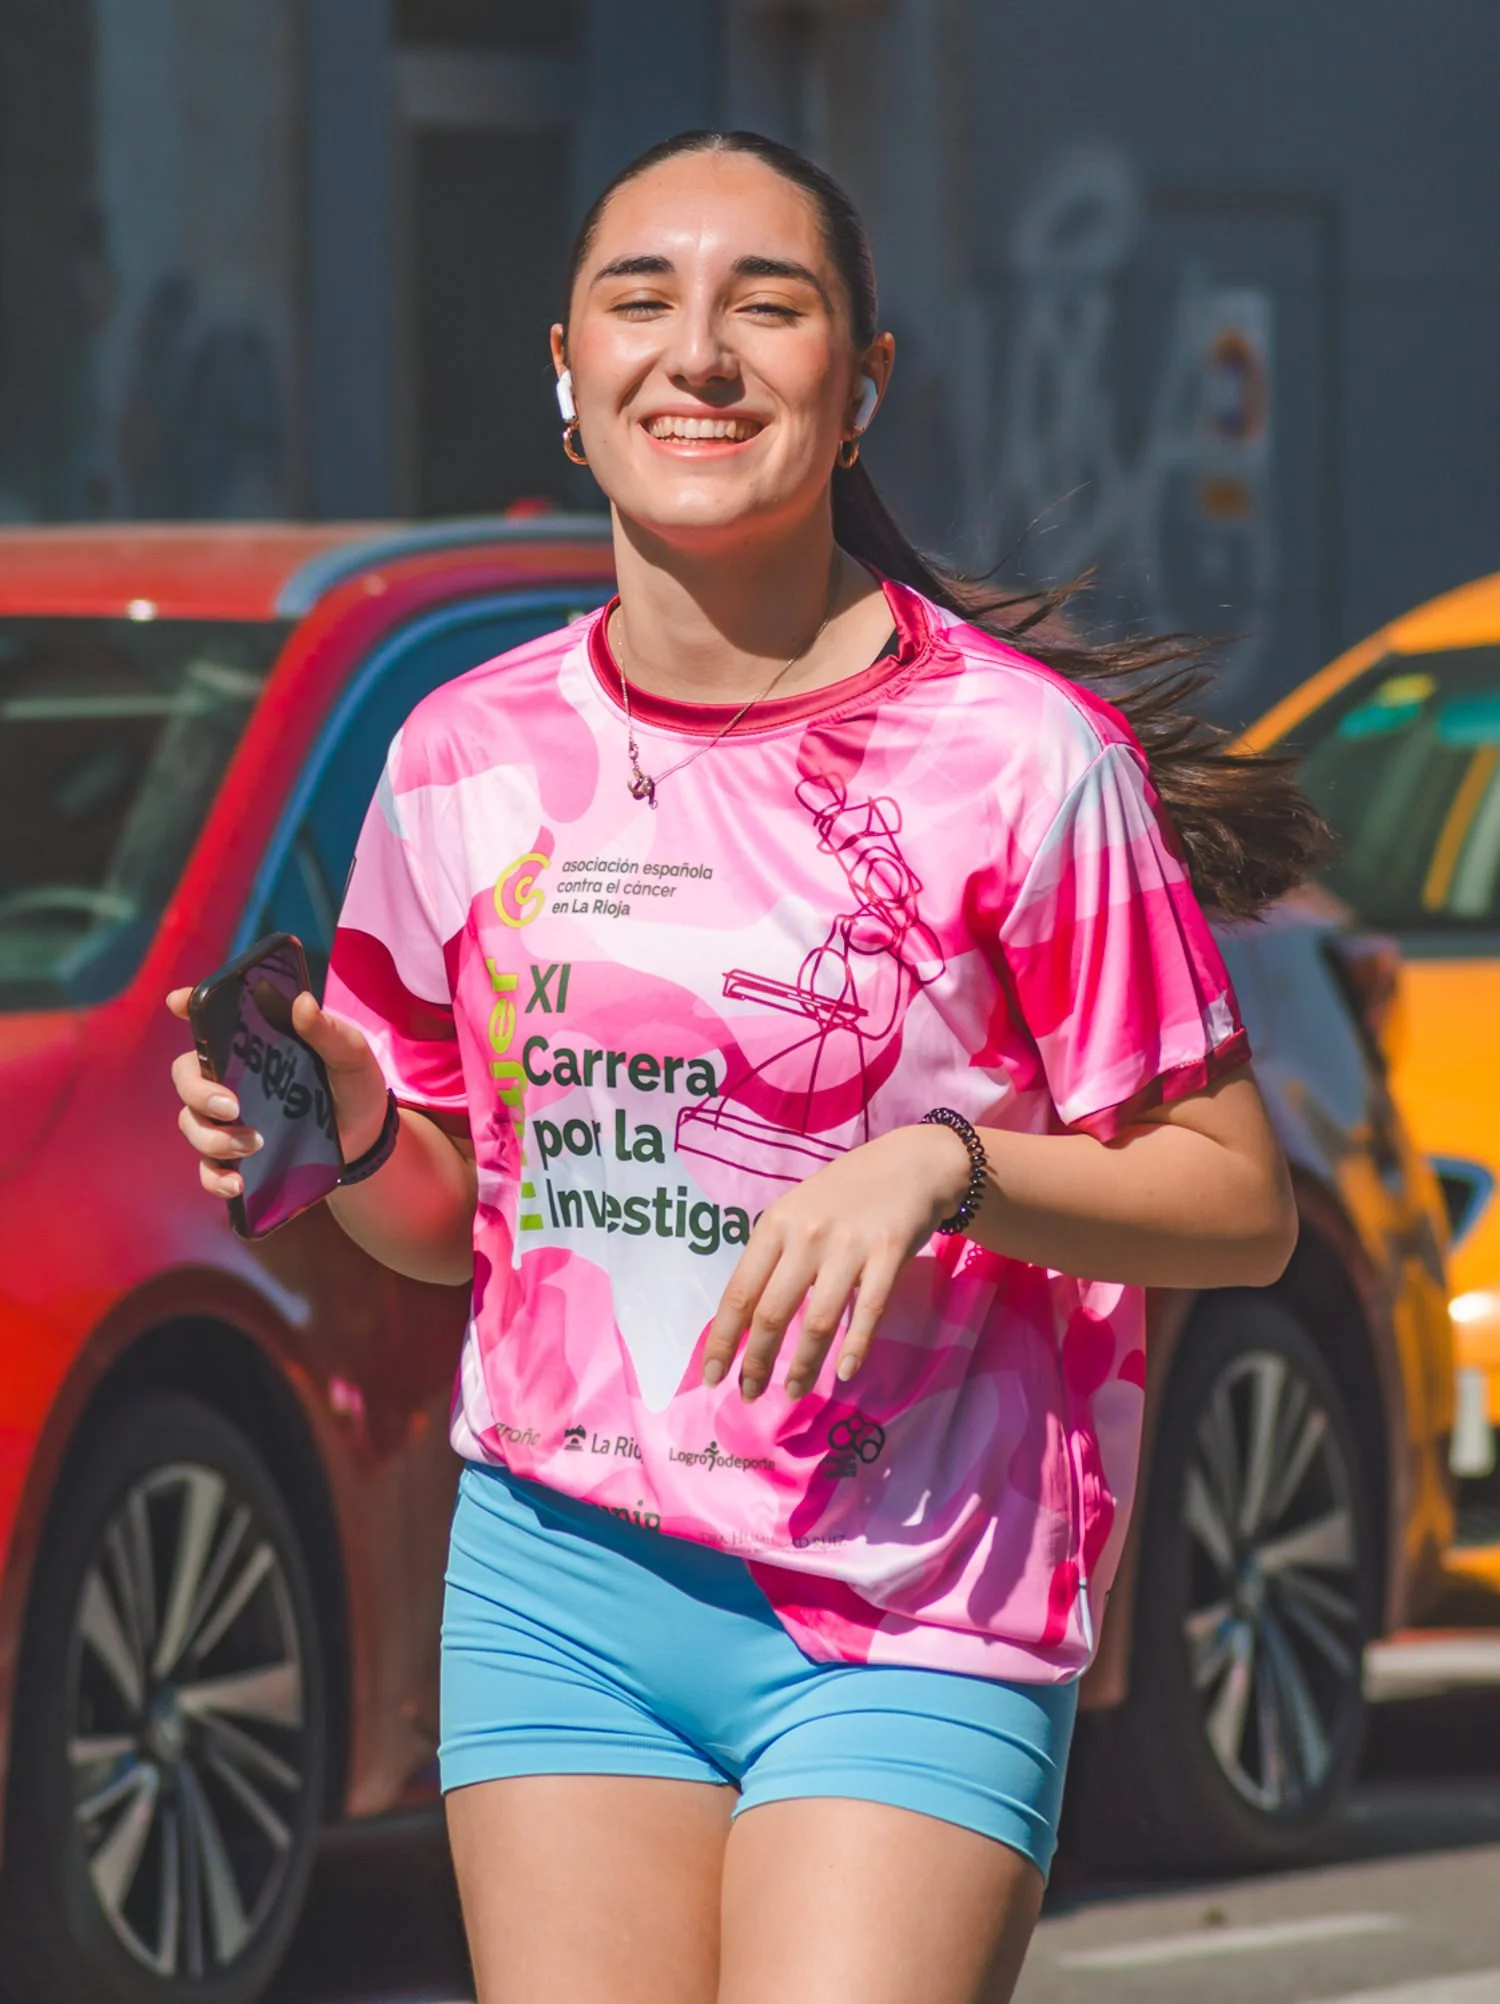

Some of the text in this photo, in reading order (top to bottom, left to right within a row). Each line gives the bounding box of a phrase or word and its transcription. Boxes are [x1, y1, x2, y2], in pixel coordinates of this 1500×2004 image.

[562, 857, 714, 880] asociación española
[556, 878, 677, 898] contra el cáncer
[551, 899, 631, 919] en La Rioja
[525, 963, 572, 1014] XI
[522, 1035, 719, 1098] Carrera
[615, 1108, 666, 1164] la
[546, 1178, 764, 1256] Investiga
[591, 1433, 611, 1455] La
